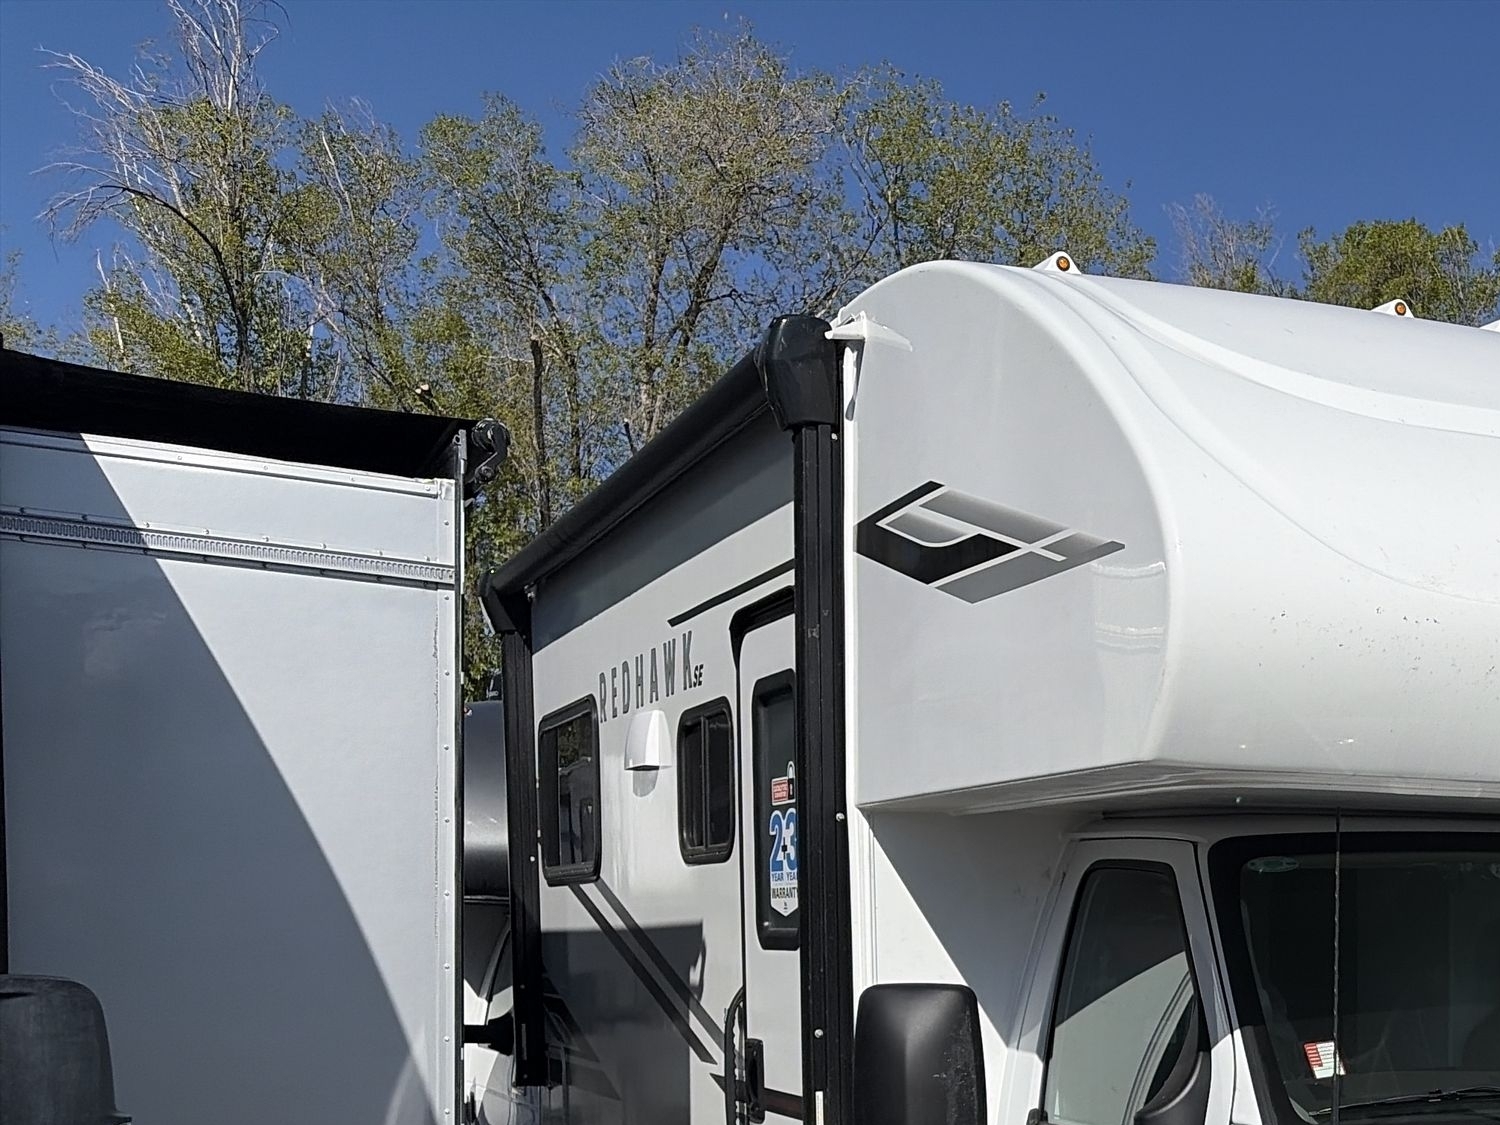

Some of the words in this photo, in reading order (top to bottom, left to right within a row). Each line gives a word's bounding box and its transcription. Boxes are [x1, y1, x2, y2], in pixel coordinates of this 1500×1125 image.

[598, 629, 693, 724] REDHAWK
[692, 663, 704, 688] SE
[786, 871, 798, 882] YEA
